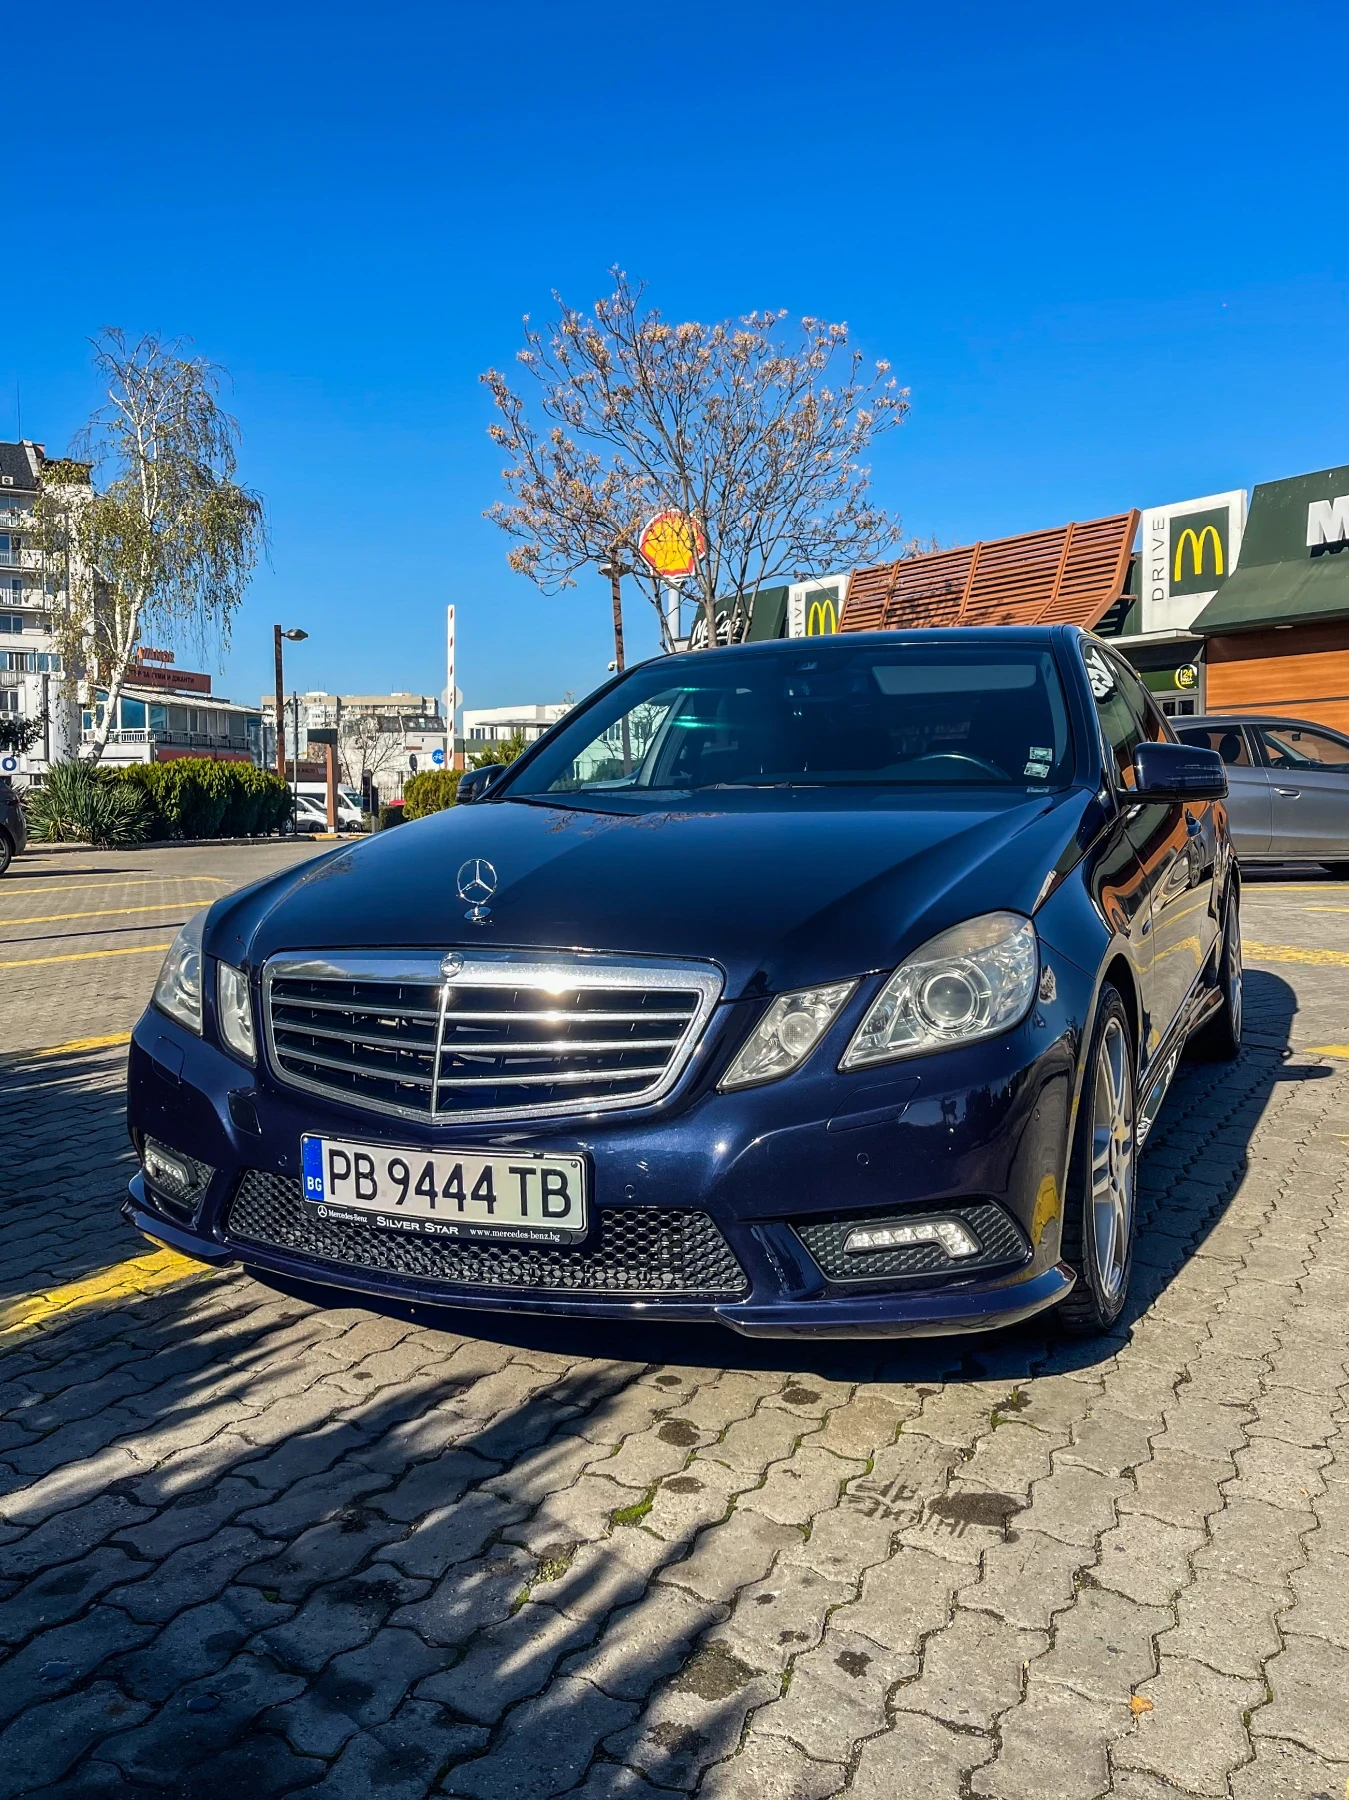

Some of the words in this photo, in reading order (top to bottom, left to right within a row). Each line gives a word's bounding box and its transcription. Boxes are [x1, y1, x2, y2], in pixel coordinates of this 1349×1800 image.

[1152, 517, 1165, 602] DRIVE
[794, 591, 803, 638] RIVE
[307, 1176, 322, 1192] BG
[328, 1148, 377, 1200] PB
[387, 1157, 497, 1214] 9444
[508, 1166, 572, 1219] TB
[328, 1209, 368, 1223] Mercedes-Benz
[376, 1216, 420, 1231] SILVER
[424, 1222, 459, 1235] STAR
[469, 1229, 561, 1243] www.mercedes-benz.bg
